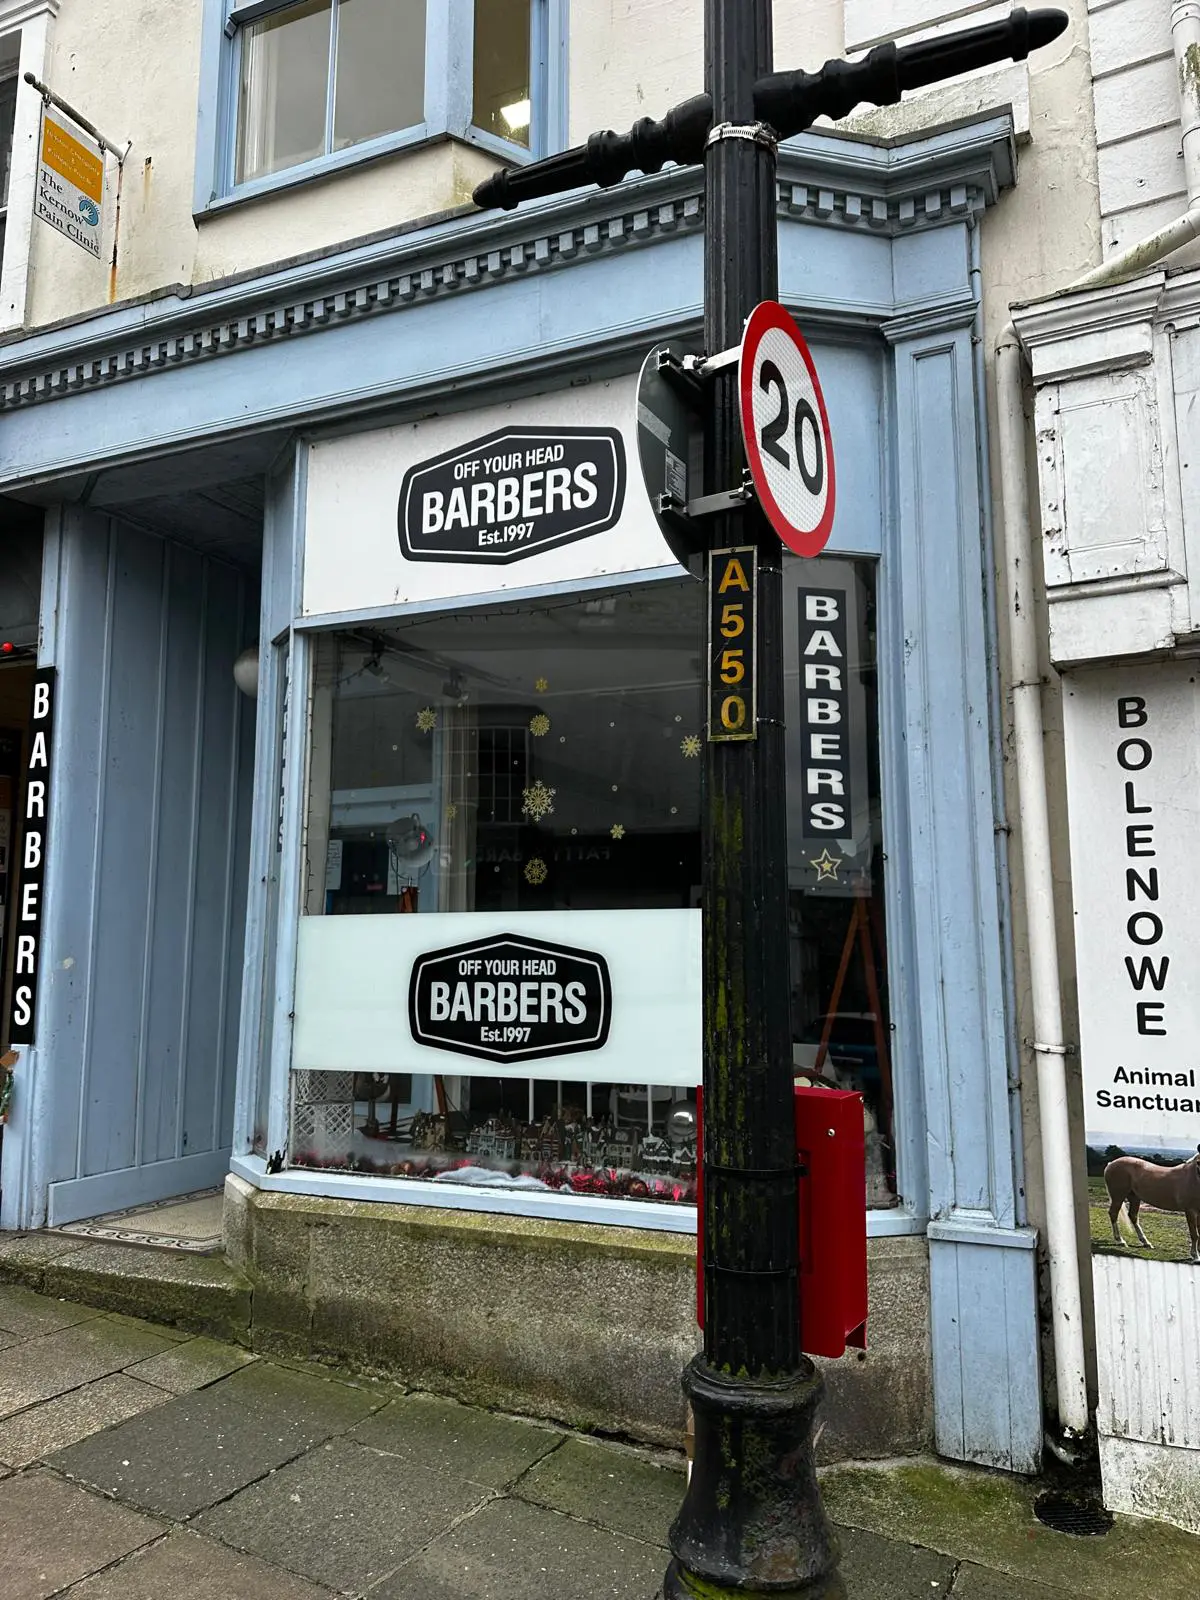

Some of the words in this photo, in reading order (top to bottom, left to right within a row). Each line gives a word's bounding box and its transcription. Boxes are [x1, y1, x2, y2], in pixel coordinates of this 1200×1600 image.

[40, 168, 63, 194] The
[39, 186, 84, 226] Kernow
[38, 202, 63, 230] Pain
[66, 221, 100, 255] Clinic
[759, 359, 824, 496] 20
[453, 460, 480, 480] OFF
[483, 452, 522, 474] YOUR
[525, 444, 564, 466] HEAD
[422, 461, 598, 535] BARBERS
[478, 521, 535, 546] Est.1997
[803, 595, 846, 830] BARBERS
[14, 682, 50, 1026] BARBERS
[1116, 696, 1170, 1037] BOLENOWE
[458, 959, 482, 976] OFF
[484, 959, 520, 976] YOUR
[522, 959, 557, 977] HEAD
[430, 981, 588, 1025] BARBERS
[480, 1026, 532, 1043] Est.1997
[1113, 1065, 1196, 1088] Animal
